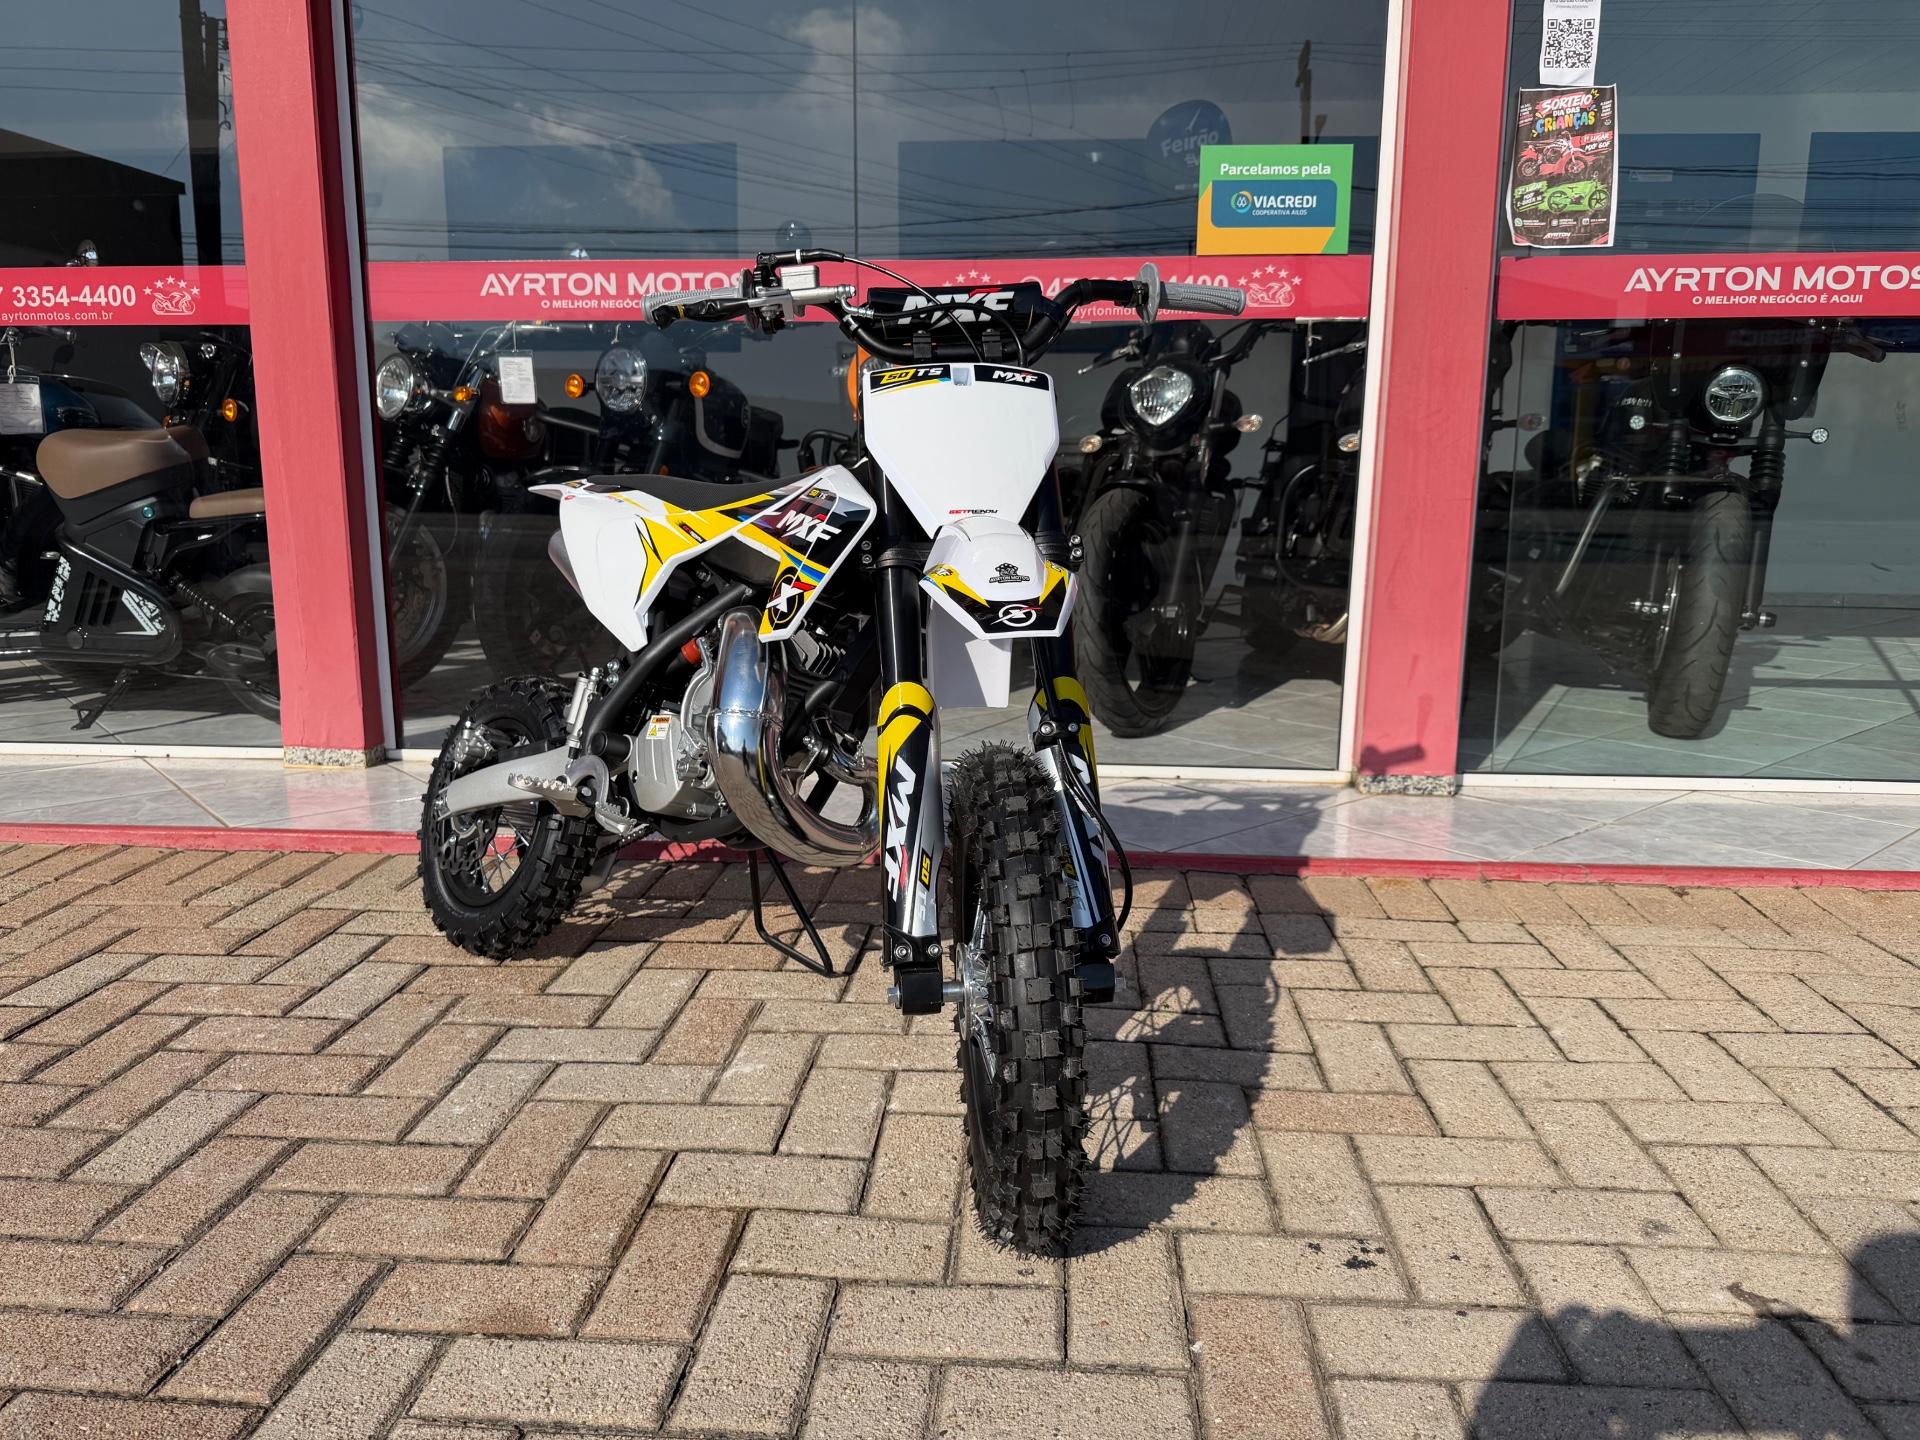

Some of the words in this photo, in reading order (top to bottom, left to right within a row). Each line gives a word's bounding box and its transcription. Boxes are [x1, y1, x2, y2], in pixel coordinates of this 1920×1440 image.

[1541, 94, 1592, 113] SORTEIO
[1553, 108, 1564, 117] DIA
[1566, 107, 1580, 115] DAS
[1160, 128, 1219, 158] Feirão
[1220, 163, 1298, 175] Parcelamos
[1302, 163, 1331, 177] pela
[1253, 195, 1317, 208] VIACREDI
[480, 272, 616, 296] AYRTON
[1624, 266, 1781, 292] AYRTON
[12, 285, 136, 307] 3354-4400
[541, 299, 550, 309] O
[552, 299, 598, 309] MELHOR
[600, 297, 641, 309] NEGÓCI
[1692, 295, 1703, 305] O
[1705, 294, 1757, 305] MELHOR
[1760, 293, 1817, 304] NEGÓCIO
[1820, 292, 1828, 303] É
[1830, 294, 1863, 304] AQUI
[898, 288, 1014, 331] MXF
[917, 367, 943, 377] TS
[993, 370, 1038, 384] MXF
[776, 510, 842, 543] MXF
[884, 755, 916, 902] MXF
[921, 854, 931, 886] 50
